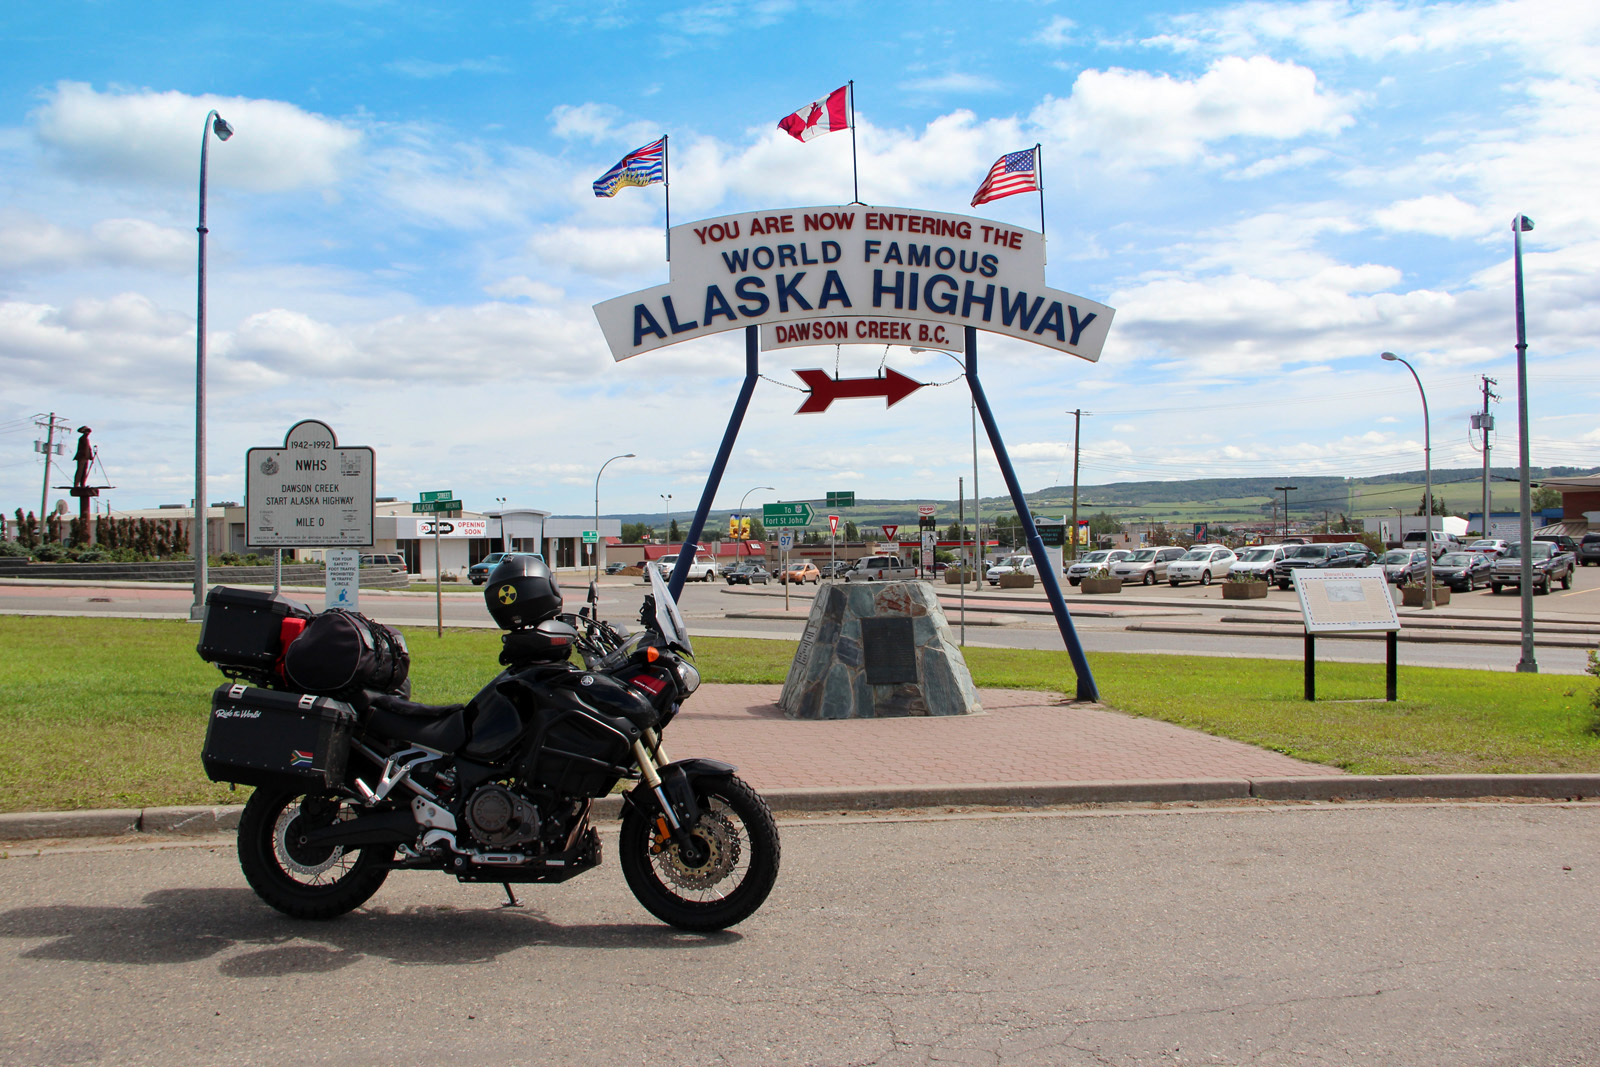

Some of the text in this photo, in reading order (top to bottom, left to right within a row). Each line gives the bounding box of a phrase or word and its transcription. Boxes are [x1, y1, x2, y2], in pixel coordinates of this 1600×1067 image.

[693, 212, 1024, 250] YOU ARE NOW ENTERING THE
[721, 240, 999, 278] WORLD FAMOUS
[633, 269, 1098, 347] ALASKA HIGHWAY
[775, 320, 950, 345] DAWSON CREEK B.C.
[291, 441, 331, 449] 1942-1992
[295, 459, 327, 471] NWHS
[281, 484, 340, 493] DAWSON CREEK
[266, 496, 354, 505] START ALASKA HIGHWAY
[437, 492, 450, 500] STREET
[415, 503, 434, 511] ALASKA
[784, 506, 792, 514] To
[296, 518, 315, 527] MILE
[780, 536, 791, 546] 97
[215, 708, 233, 719] Ride
[240, 709, 262, 719] World
